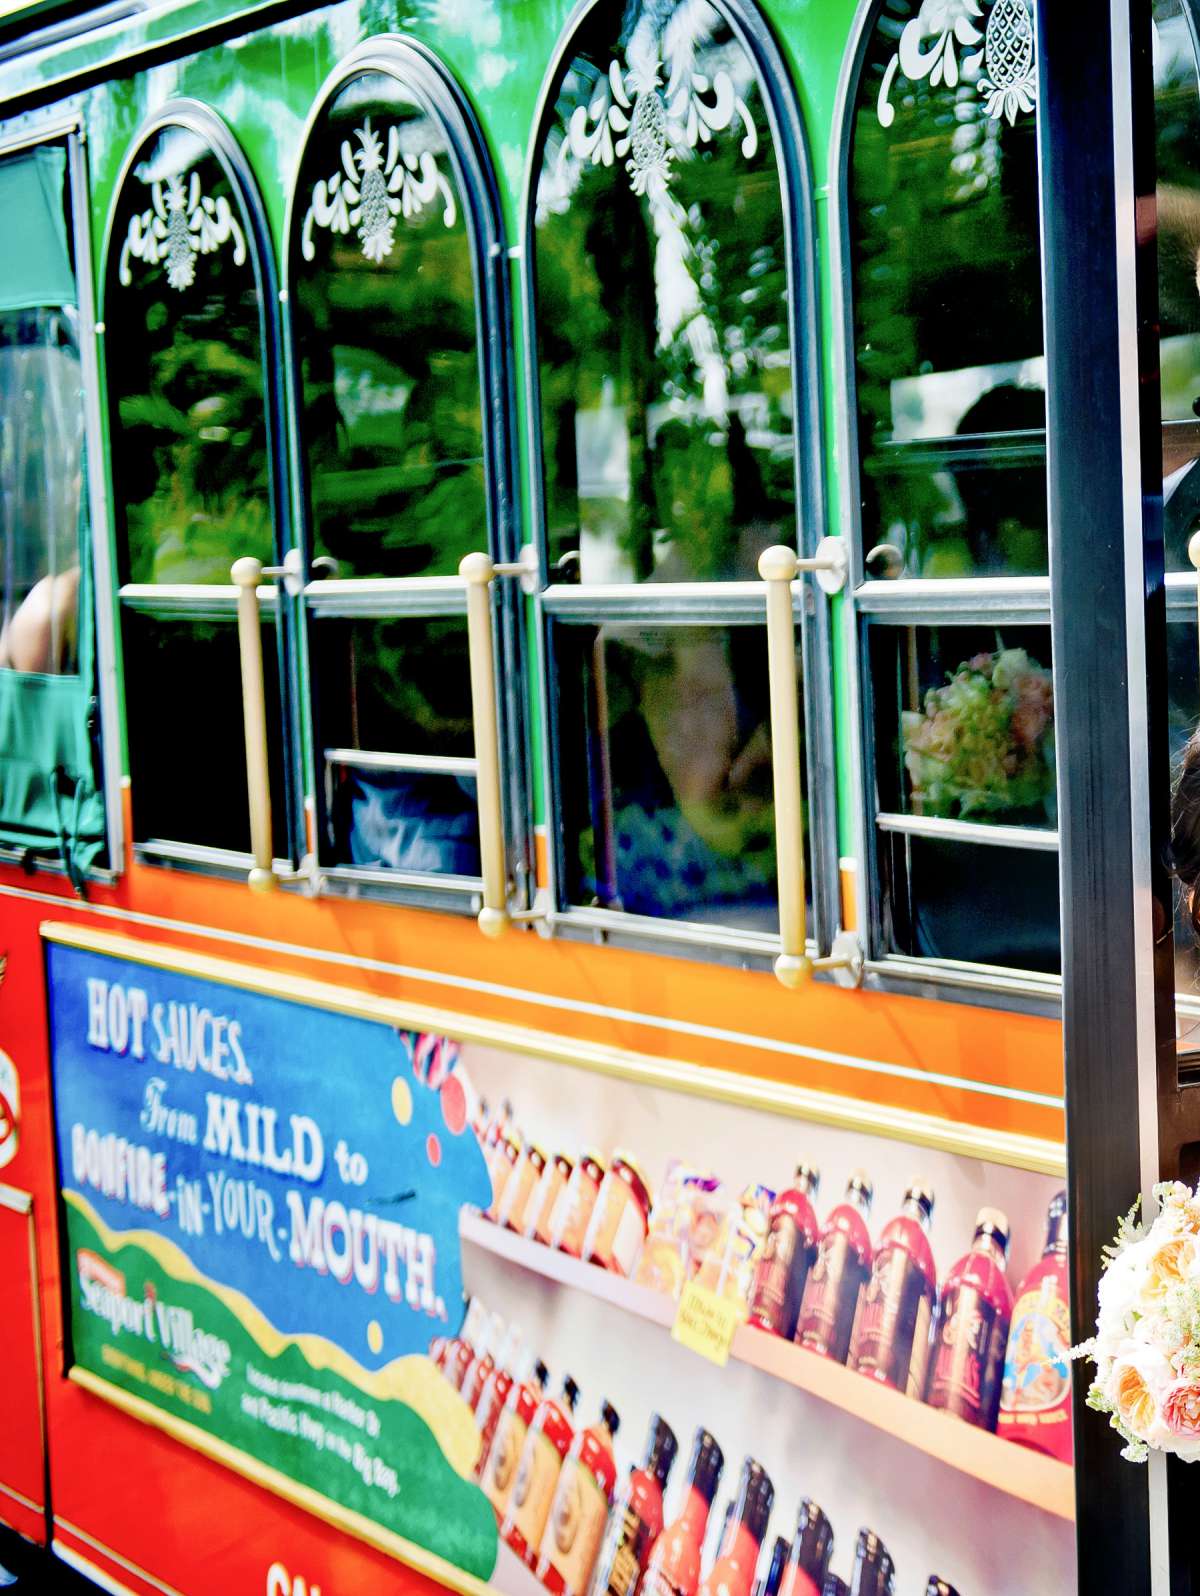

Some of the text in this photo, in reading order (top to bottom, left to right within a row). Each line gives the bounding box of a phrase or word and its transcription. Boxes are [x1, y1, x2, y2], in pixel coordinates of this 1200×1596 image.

[87, 976, 149, 1064] HOT
[140, 1077, 369, 1186] From MILD to
[80, 1272, 157, 1344] Seaport
[156, 1301, 232, 1389] Village
